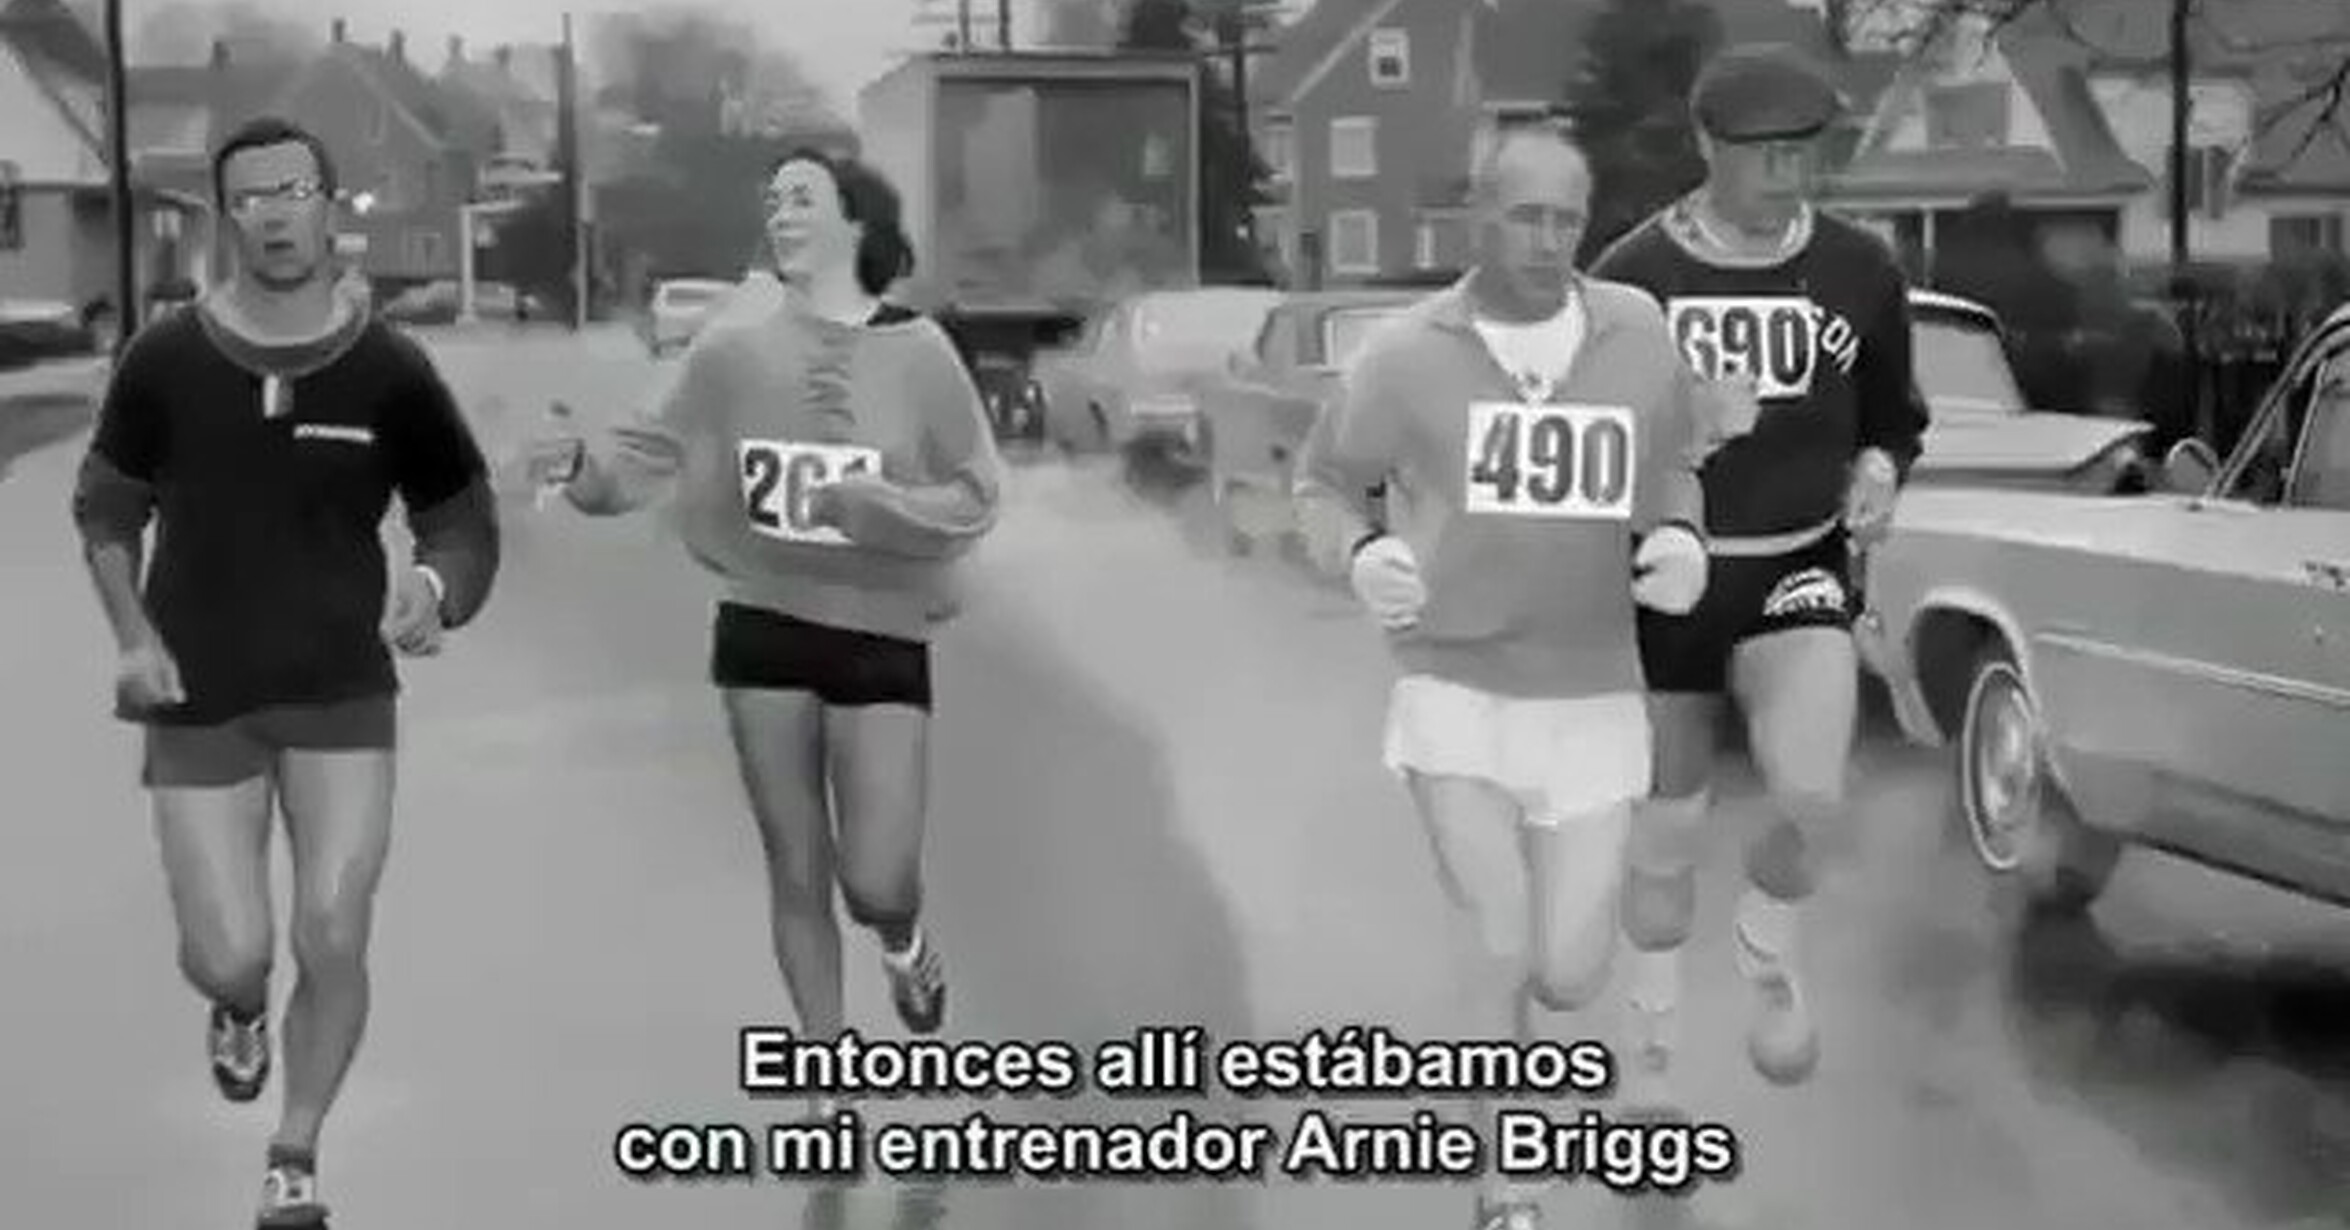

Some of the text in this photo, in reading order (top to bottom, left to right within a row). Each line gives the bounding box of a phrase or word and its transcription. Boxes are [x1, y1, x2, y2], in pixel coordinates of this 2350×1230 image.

[1677, 305, 1810, 386] 690
[745, 449, 868, 530] 26
[1471, 413, 1628, 504] 490
